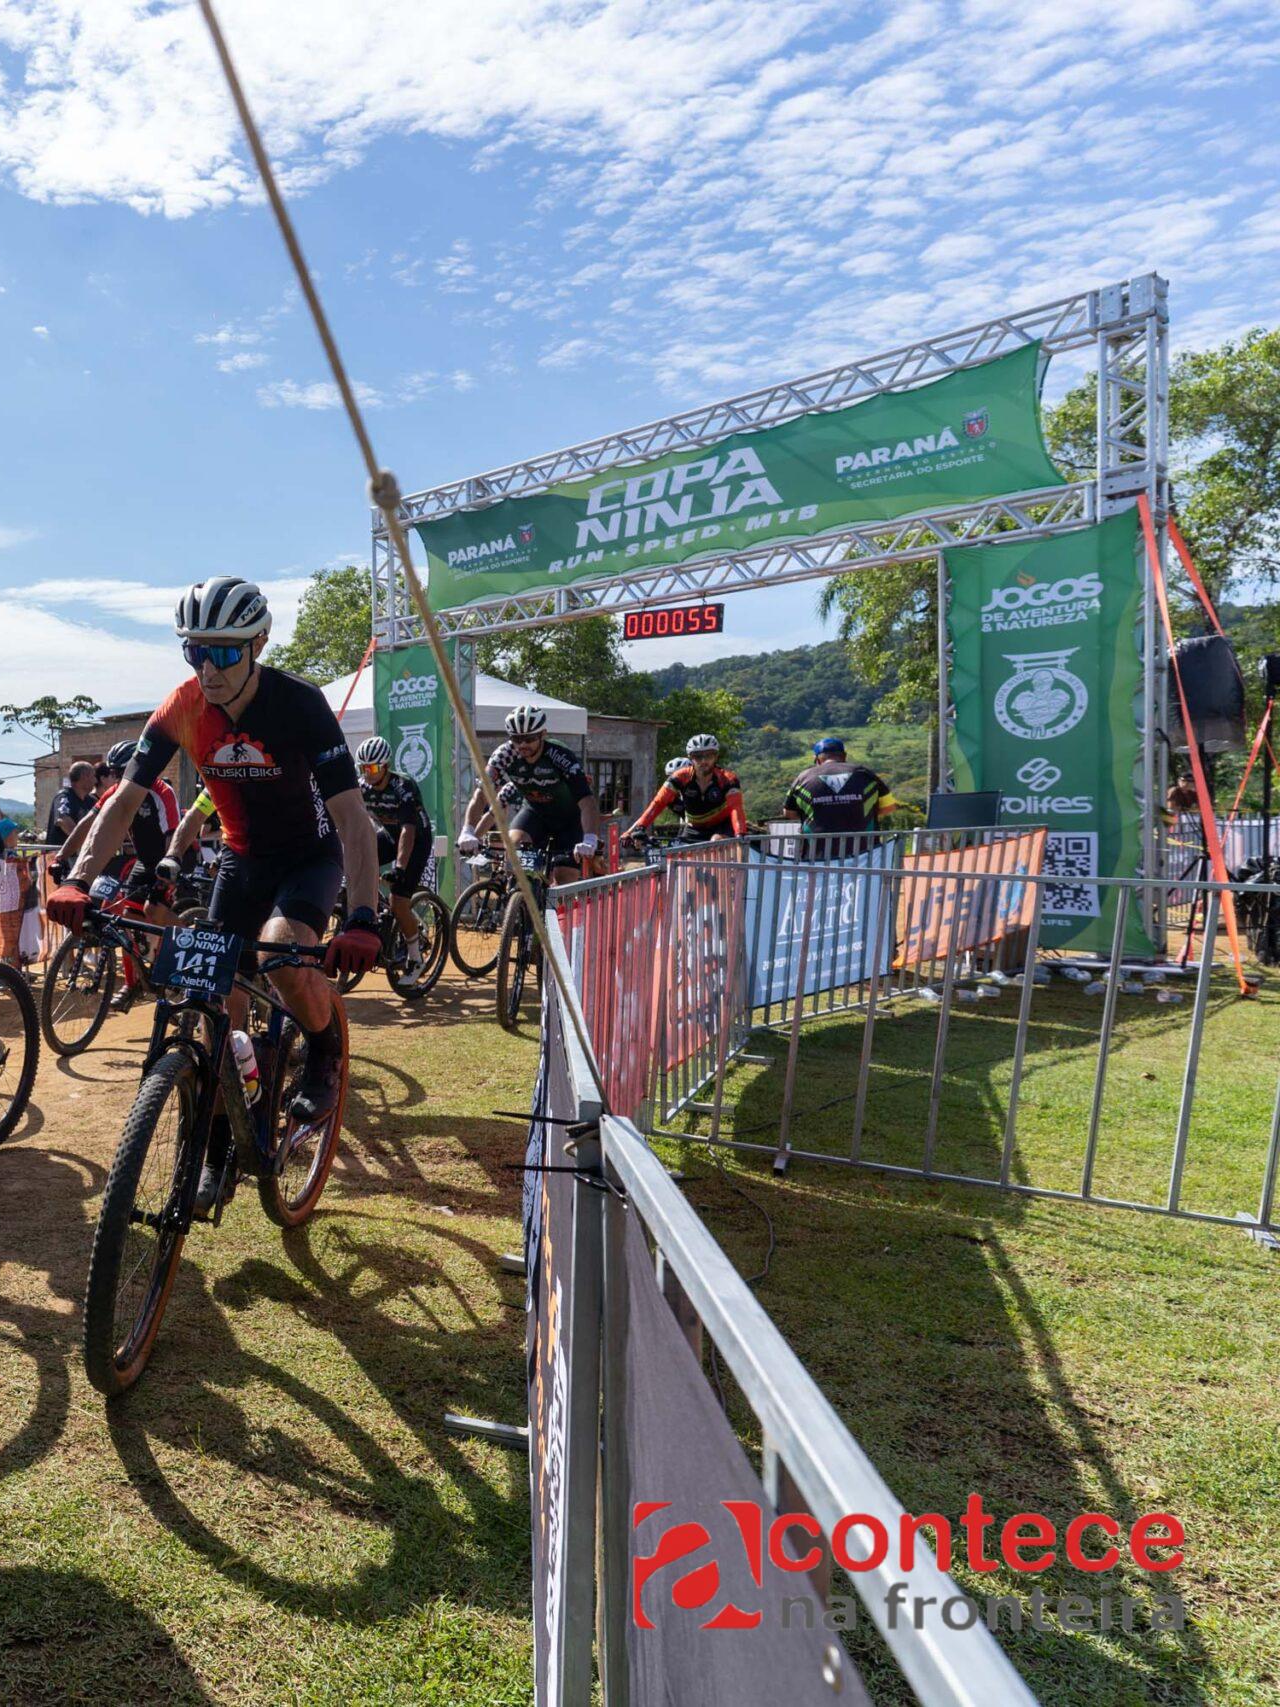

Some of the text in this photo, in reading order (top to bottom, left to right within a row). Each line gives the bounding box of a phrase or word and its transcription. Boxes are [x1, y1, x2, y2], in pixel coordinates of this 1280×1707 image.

[835, 426, 959, 474] PARANÁ
[587, 447, 765, 516] COPA
[850, 453, 985, 490] SECRETARIA DO ESPORTE
[576, 477, 783, 548] NINJA
[448, 534, 517, 567] PARANÁ
[548, 549, 604, 574] RUN
[625, 524, 720, 558] SPEED
[744, 504, 819, 533] MTB
[981, 572, 1104, 613] JOGOS
[627, 606, 717, 636] 000055
[981, 597, 1101, 623] DE AVENTURA
[981, 611, 1088, 633] & NATUREZA
[388, 675, 438, 695] JOGOS
[388, 691, 437, 704] DE AVENTURA
[395, 699, 431, 710] NATUREZA
[250, 766, 283, 777] BIKE
[194, 940, 226, 954] NINJA
[196, 931, 225, 944] COPA
[174, 951, 217, 977] 141
[180, 975, 216, 991] Netfly
